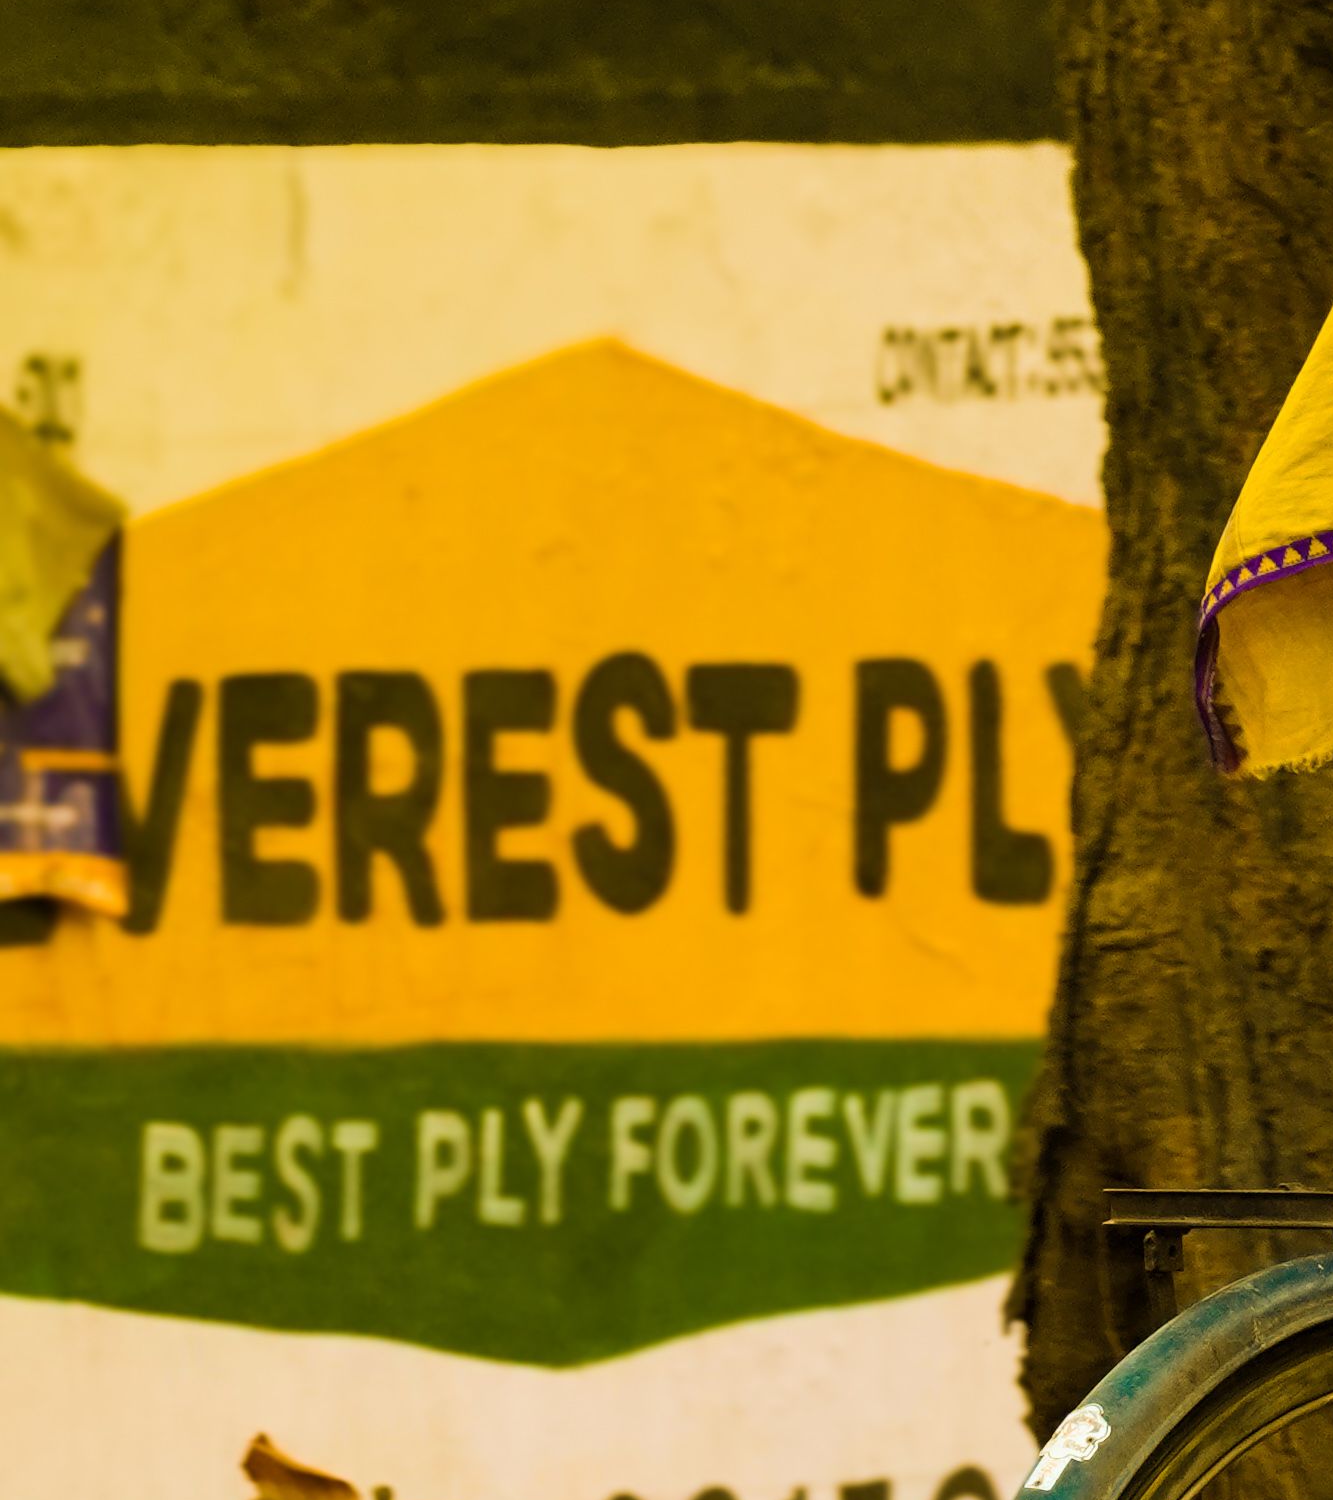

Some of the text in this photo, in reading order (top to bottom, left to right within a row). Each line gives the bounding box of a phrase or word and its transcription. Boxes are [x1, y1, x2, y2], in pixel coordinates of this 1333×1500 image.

[0, 650, 802, 947] VEREST
[138, 1079, 1010, 1254] BEST PLY FOREVER
